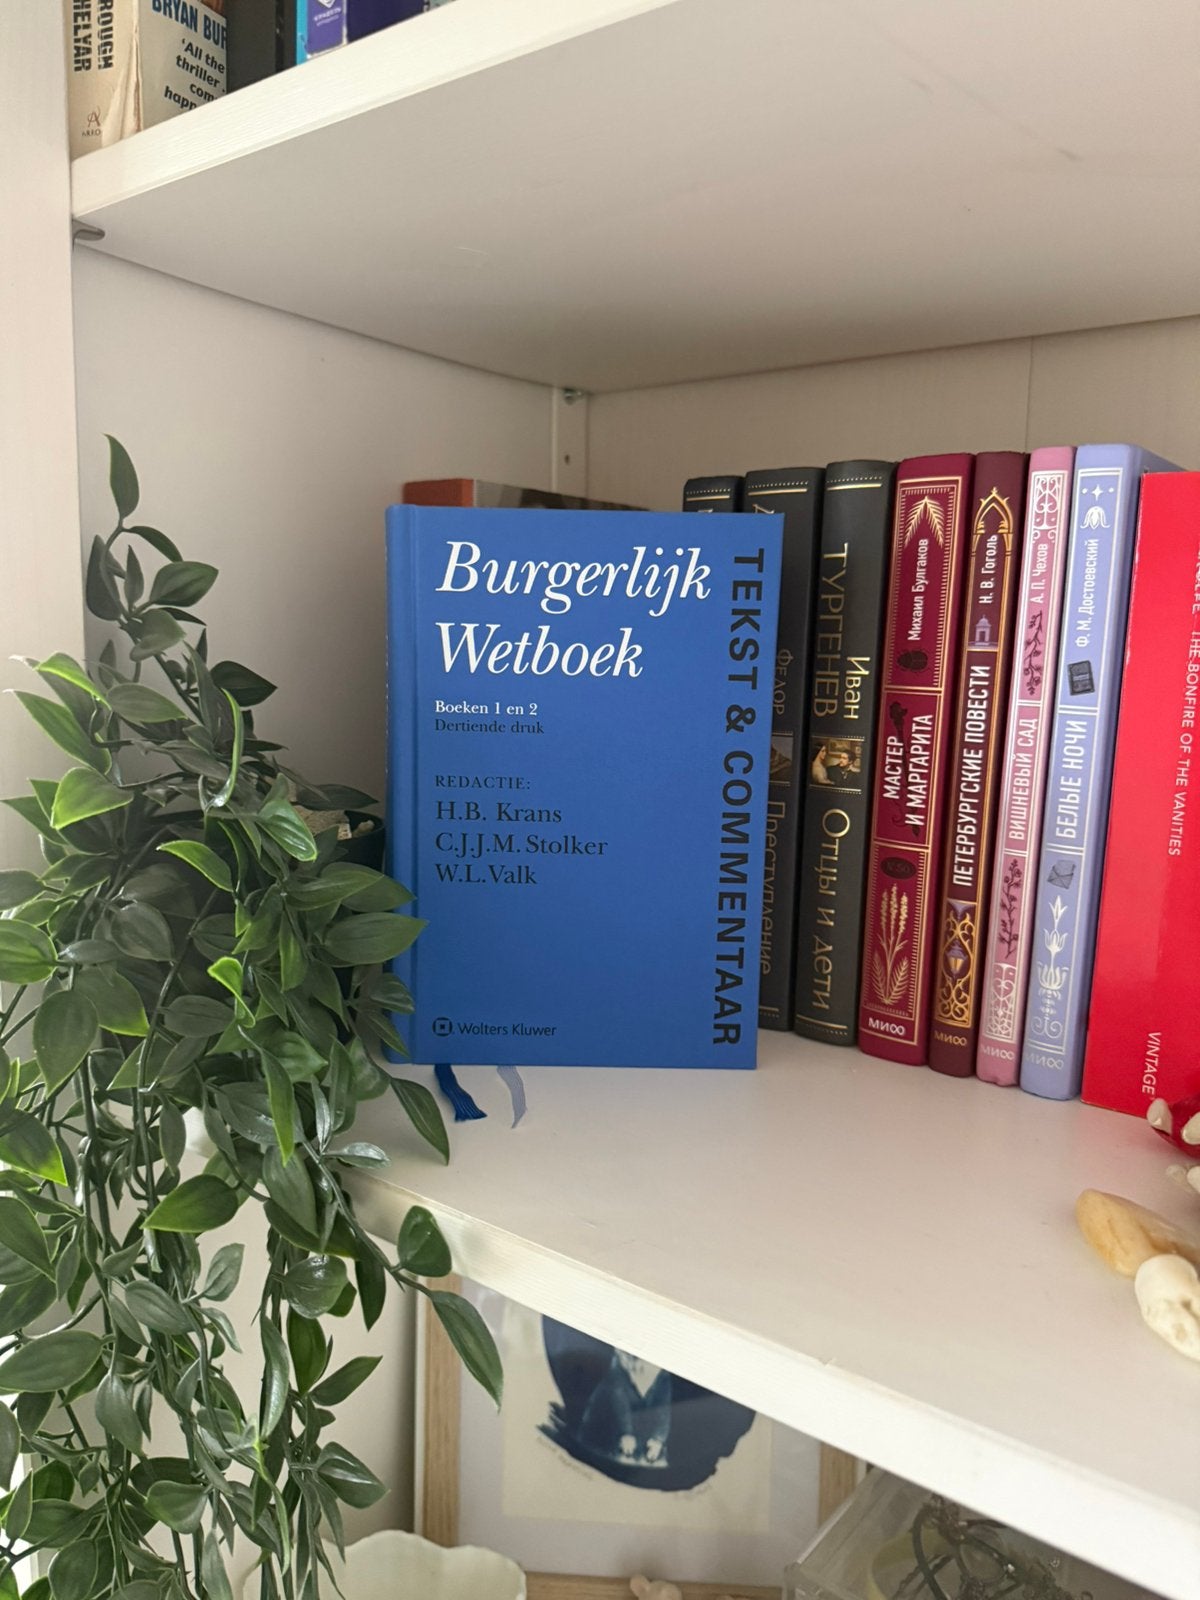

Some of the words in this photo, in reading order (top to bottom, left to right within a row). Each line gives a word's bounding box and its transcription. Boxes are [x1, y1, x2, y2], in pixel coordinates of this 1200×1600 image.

[176, 55, 220, 87] thriller
[205, 54, 225, 74] the
[190, 83, 217, 102] com
[911, 538, 929, 592] Булгаков
[981, 535, 998, 574] Гоголь
[1032, 544, 1048, 576] Чехов
[435, 540, 712, 617] Burgerlijk
[980, 578, 994, 588] В.
[1031, 579, 1045, 589] П.
[1078, 539, 1099, 616] Достоевский
[979, 593, 993, 604] Н.
[1030, 593, 1044, 604] А.
[728, 548, 764, 690] TEKST
[812, 542, 848, 717] ТУРГЕНЕВ
[907, 596, 924, 641] Михаил
[1076, 617, 1092, 631] М.
[435, 622, 643, 678] Wetboek
[1075, 633, 1090, 648] Ф.
[843, 657, 871, 719] Иван
[964, 666, 991, 743] ПОВЕСТИ
[1182, 663, 1199, 728] BONFIRE
[435, 700, 489, 714] Boeken
[494, 702, 501, 715] 1
[506, 704, 524, 715] en
[529, 703, 538, 715] 2
[726, 704, 757, 733] &
[435, 718, 506, 733] Dertiende
[510, 721, 545, 734] druk
[1017, 719, 1038, 747] САД
[1180, 733, 1193, 753] OF
[906, 714, 933, 808] МАРГАРИТА
[1062, 721, 1087, 769] НОЧИ
[435, 775, 531, 790] REDACTIE:
[883, 735, 904, 799] МАСТЕР
[1176, 759, 1190, 786] THE
[436, 800, 487, 821] H.B.
[496, 802, 562, 823] Krans
[1009, 752, 1033, 840] ВИШНЕВЫЙ
[1056, 776, 1081, 838] БЕЛЫЕ
[905, 816, 925, 826] И
[953, 748, 983, 886] ПЕТЕРБУРГСКИЕ
[1169, 791, 1187, 856] VANITIES
[526, 834, 608, 855] Stolker
[818, 809, 850, 895] Отцы
[713, 751, 754, 1045] COMMENTAAR
[817, 909, 836, 927] и
[812, 935, 833, 1010] дети
[457, 1022, 508, 1035] Wolters
[512, 1023, 557, 1036] Kluwer
[1142, 1032, 1161, 1095] VINTAGE
